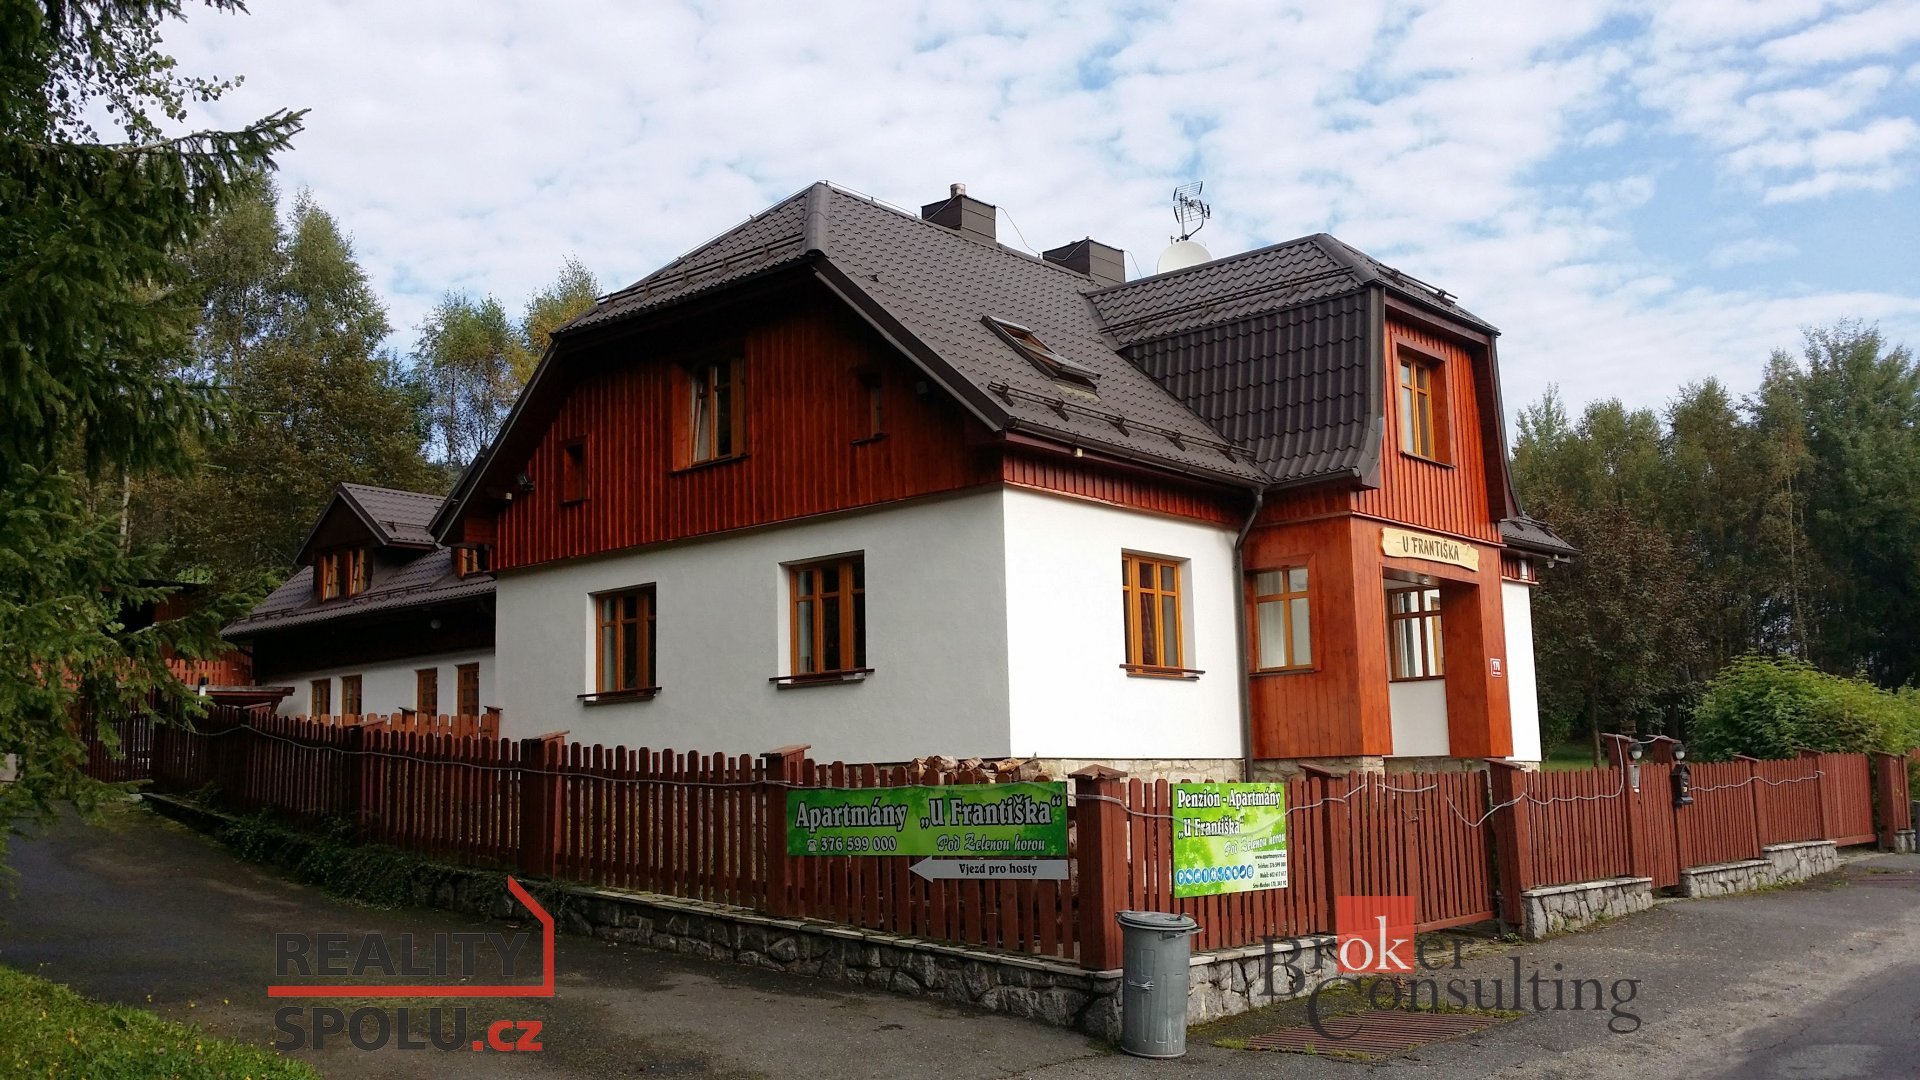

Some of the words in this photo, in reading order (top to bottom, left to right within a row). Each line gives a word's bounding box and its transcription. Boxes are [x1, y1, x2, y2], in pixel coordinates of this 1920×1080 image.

[1402, 535, 1409, 553] U
[1411, 536, 1460, 561] FRANTIŠKA
[1177, 789, 1220, 808] Penzion
[1228, 787, 1281, 810] Apartmány
[795, 797, 908, 832] Apartmány
[821, 836, 843, 851] 376
[847, 836, 870, 851] 599
[873, 835, 897, 851] 000
[936, 835, 960, 851] Pod
[965, 832, 1010, 851] Zelenou
[1014, 834, 1045, 851] horou
[959, 863, 986, 875] Vjezd
[989, 865, 1007, 875] pro
[1009, 862, 1038, 875] hosty
